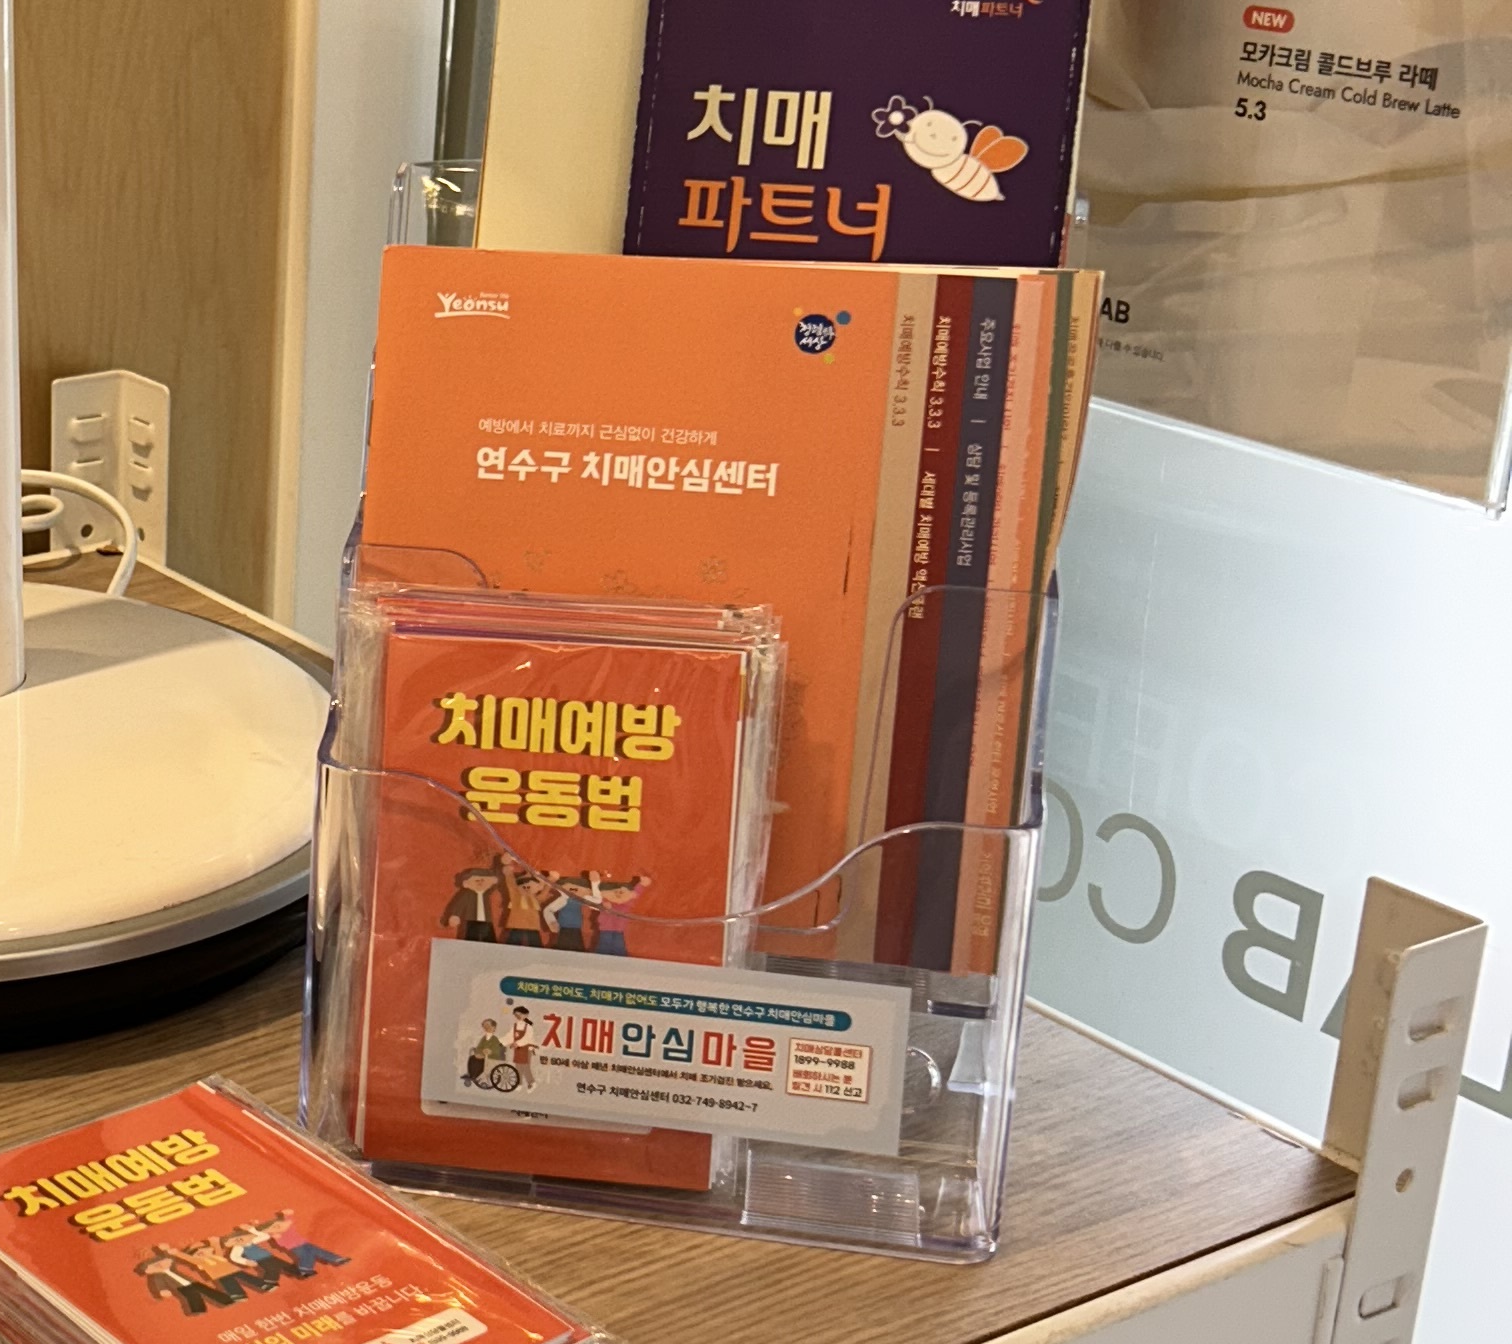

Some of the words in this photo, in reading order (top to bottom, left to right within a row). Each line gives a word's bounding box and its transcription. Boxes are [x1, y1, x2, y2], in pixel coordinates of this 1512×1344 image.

[950, 0, 1024, 18] 치매파트너
[1251, 11, 1287, 28] NEW
[1240, 42, 1312, 72] 모카크림
[1317, 52, 1391, 83] 콜드브루
[1399, 64, 1438, 91] 라떼
[1235, 98, 1266, 121] 5.3
[1238, 71, 1283, 91] Mocha
[1289, 79, 1335, 100] Cream
[1342, 87, 1376, 106] Cold
[1383, 93, 1419, 111] Brew
[1425, 99, 1460, 119] Latte
[686, 84, 833, 170] 치매
[678, 176, 891, 263] 파트너
[437, 291, 509, 314] Yeonsu
[895, 314, 915, 391] 치매예방수칙
[930, 315, 952, 393] 치매예방수칙
[975, 317, 997, 370] 주요사업
[972, 373, 991, 400] 안내
[478, 418, 534, 435] 예방에서
[539, 421, 595, 439] 치료까지
[599, 424, 656, 443] 근심없이
[662, 428, 718, 447] 건강하게
[927, 396, 944, 429] 3.3.3
[476, 446, 573, 483] 연수구
[581, 451, 780, 497] 치매안심센터
[963, 473, 981, 486] 및
[965, 442, 983, 469] 상담
[919, 471, 936, 510] 세대별
[913, 514, 934, 564] 치매예방
[956, 490, 980, 567] 등록관리사업
[440, 692, 681, 762] 치매예방
[465, 766, 643, 833] 운동법
[517, 981, 549, 994] 치매가
[590, 989, 624, 1003] 치매가
[662, 997, 694, 1010] 모두가
[696, 1000, 729, 1015] 행복한
[732, 1004, 765, 1018] 연수구
[767, 1008, 835, 1027] 치매안심마을
[541, 1013, 776, 1072] 치매안심마을
[795, 1055, 855, 1070] 1899-9988
[576, 1082, 606, 1096] 연수구
[609, 1086, 670, 1102] 치매안심센터
[826, 1085, 839, 1095] 112
[844, 1087, 862, 1097] 신고
[3, 1128, 223, 1219] 치매예방
[73, 1171, 248, 1243] 운동법
[217, 1326, 258, 1344] 매일
[254, 1312, 291, 1333] 한번
[296, 1274, 393, 1319] 치매예방운동
[291, 1313, 356, 1340] 미래를
[353, 1283, 425, 1317] 바꿉니다.
